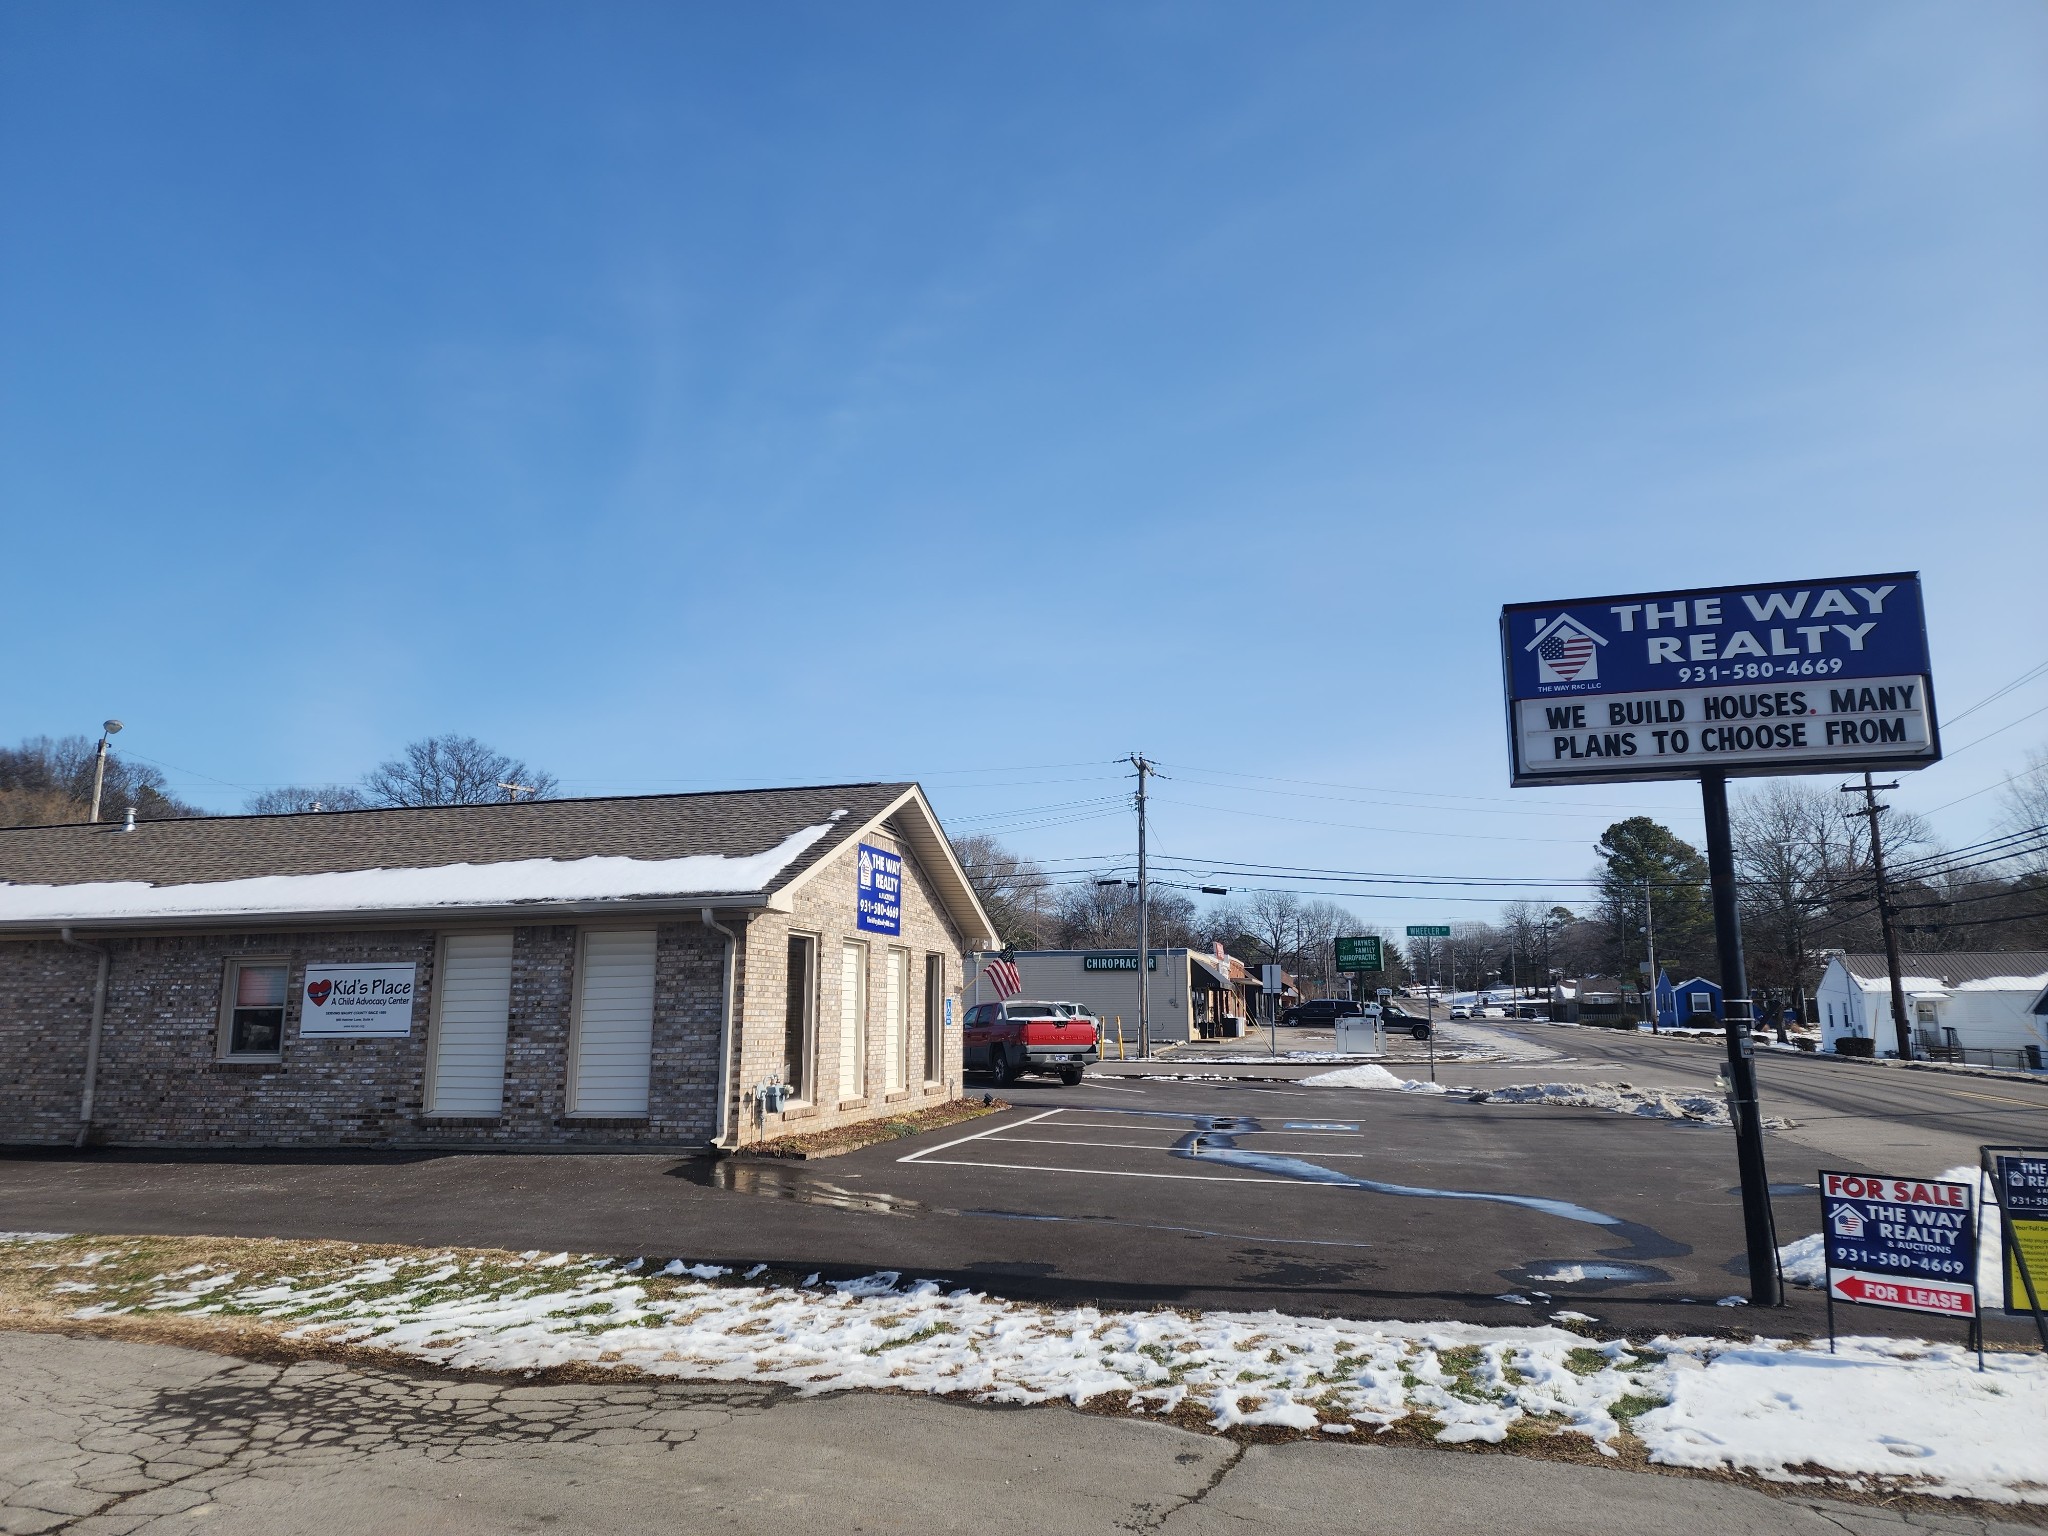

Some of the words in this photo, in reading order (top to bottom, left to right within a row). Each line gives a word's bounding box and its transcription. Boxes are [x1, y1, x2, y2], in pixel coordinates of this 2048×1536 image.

[1610, 597, 1723, 632] THE
[1741, 585, 1898, 623] WAY
[1647, 622, 1877, 665] REALTY
[1678, 657, 1843, 683] 931-580-4669
[1546, 705, 1587, 730] WE
[1609, 699, 1685, 726] BUILD
[1704, 691, 1817, 722] HOUSES.
[1830, 684, 1915, 713] MANY
[1554, 732, 1637, 760] PLANS
[1652, 728, 1689, 754] TO
[1701, 722, 1806, 752] CHOOSE
[1826, 717, 1907, 746] FROM
[872, 854, 884, 871] THE
[886, 858, 900, 875] WAY
[875, 873, 898, 892] REALTY
[860, 898, 899, 919] 931-580-4669
[1410, 927, 1440, 936] WHEELER
[1353, 939, 1376, 947] HAYNES
[1086, 958, 1155, 969] CHIROPRACR
[1340, 953, 1377, 961] CHIROPRACTIC
[333, 979, 368, 996] Kid's
[372, 979, 411, 995] Place
[338, 997, 354, 1005] Child
[355, 997, 387, 1007] Advocacy
[388, 996, 410, 1005] Center
[2020, 1162, 2047, 1174] THE
[1828, 1175, 1885, 1200] FOR
[1894, 1181, 1965, 1208] SALE
[1866, 1204, 1907, 1223] THE
[1912, 1209, 1967, 1229] WAY
[1879, 1222, 1960, 1246] REALTY
[1887, 1240, 1895, 1248] &
[1898, 1241, 1952, 1255] AUCTIONS
[1837, 1247, 1964, 1275] 931-580-4669
[1864, 1284, 1899, 1302] FOR
[1907, 1289, 1963, 1310] LEASE
